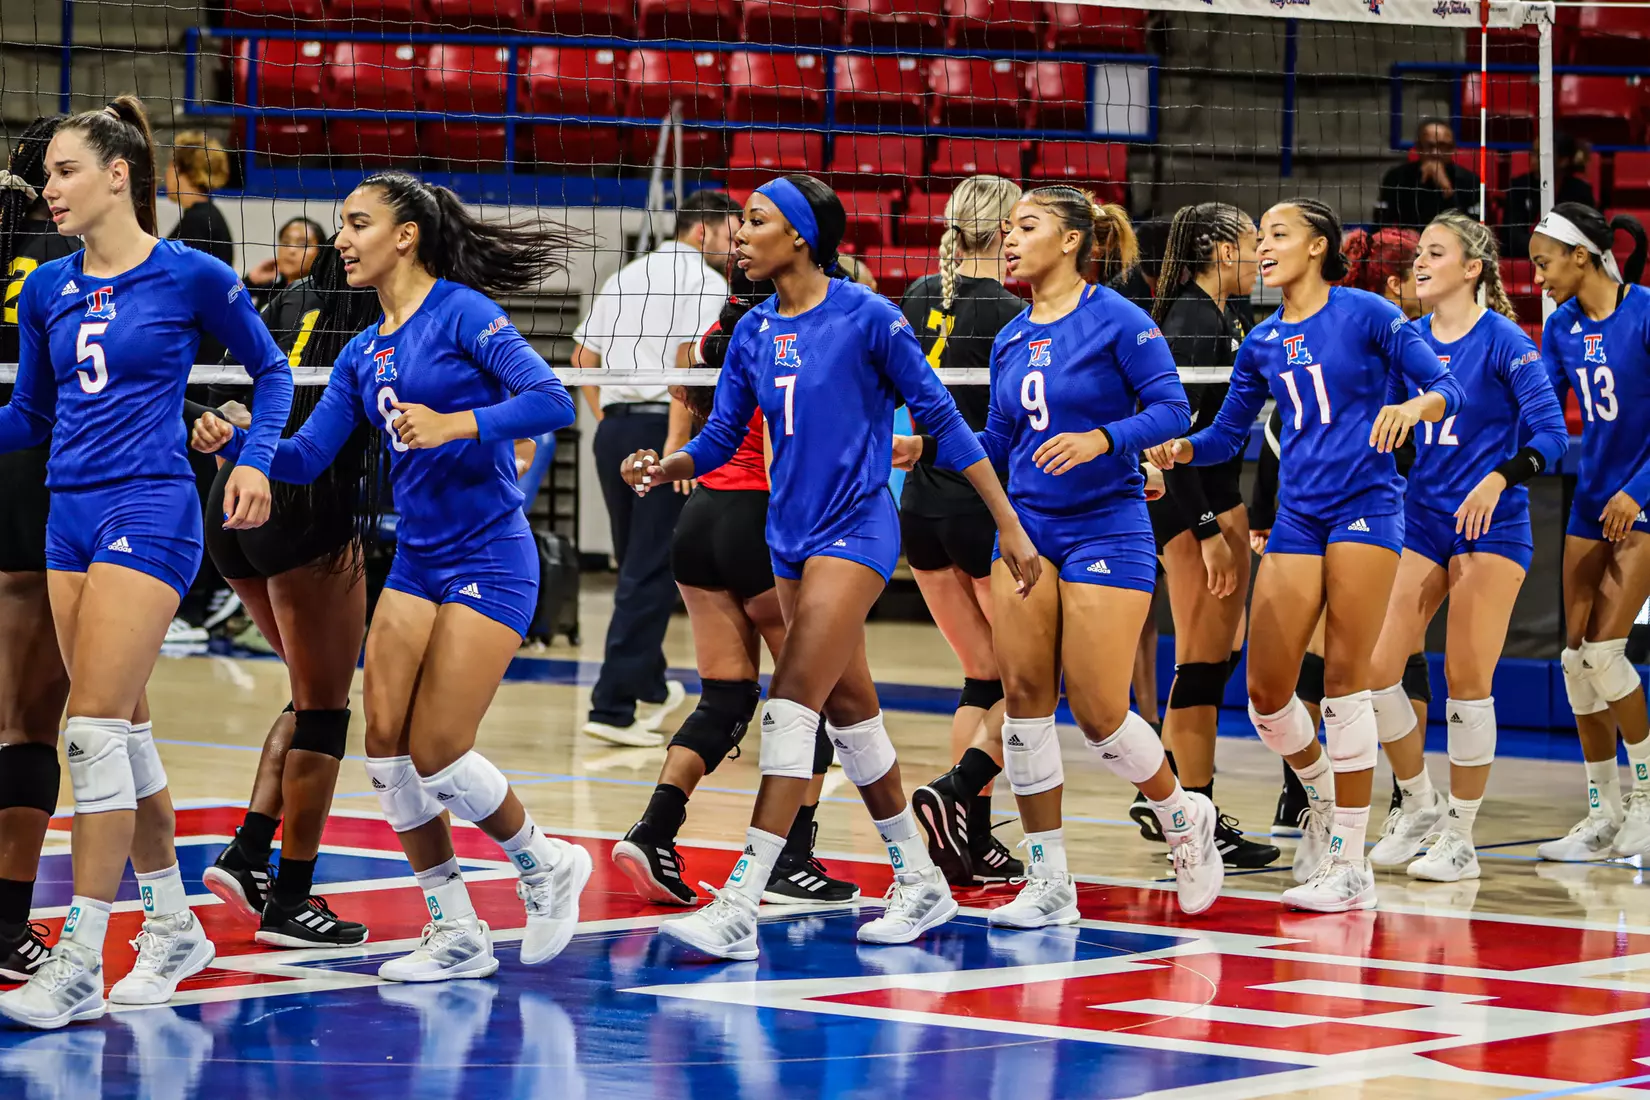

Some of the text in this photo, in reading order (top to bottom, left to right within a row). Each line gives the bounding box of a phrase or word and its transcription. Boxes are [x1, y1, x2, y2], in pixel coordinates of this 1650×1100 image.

[76, 321, 110, 395] 5
[774, 374, 797, 436] 7
[1020, 370, 1050, 432] 9
[1278, 363, 1332, 431] 11
[1575, 365, 1619, 422] 13
[107, 544, 133, 554] adidas
[1086, 566, 1111, 574] adidas
[458, 589, 482, 599] adidas
